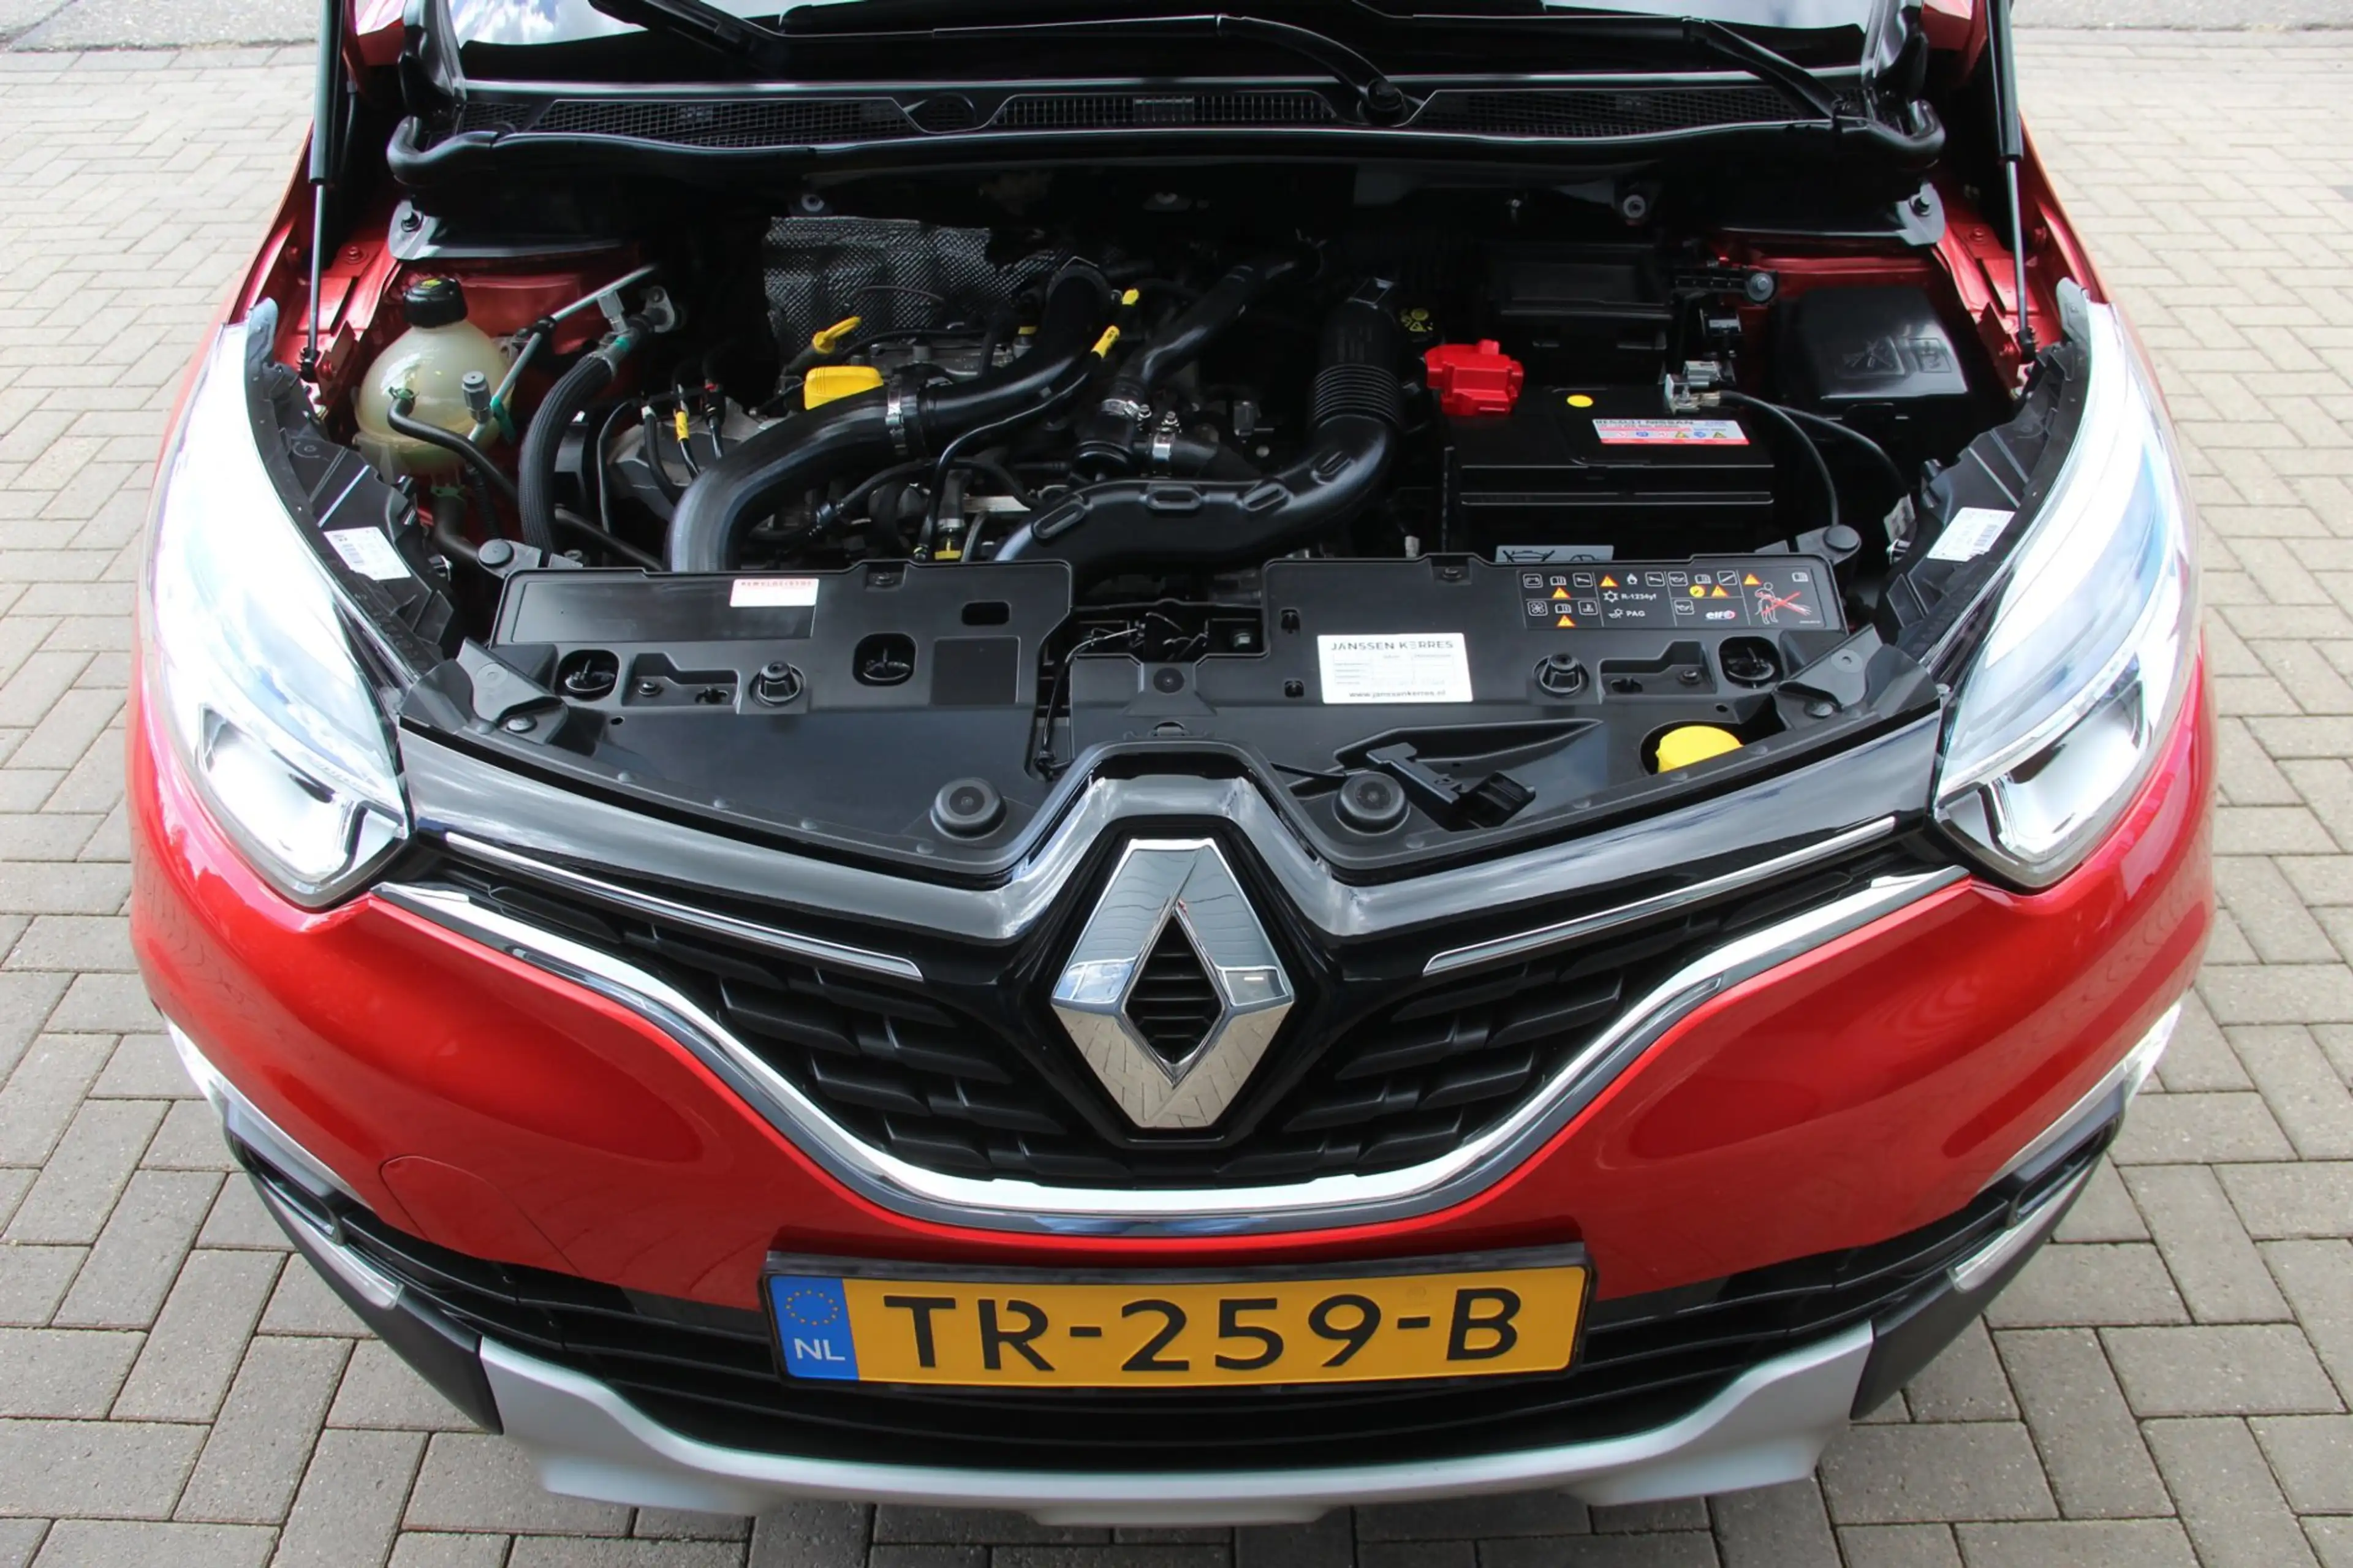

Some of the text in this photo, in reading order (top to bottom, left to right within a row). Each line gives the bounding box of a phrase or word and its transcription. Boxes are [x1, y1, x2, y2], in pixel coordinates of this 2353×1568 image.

[1330, 640, 1453, 651] JANSSEN KERRES
[883, 1287, 1522, 1373] TR-259-B
[794, 1338, 846, 1361] NL
